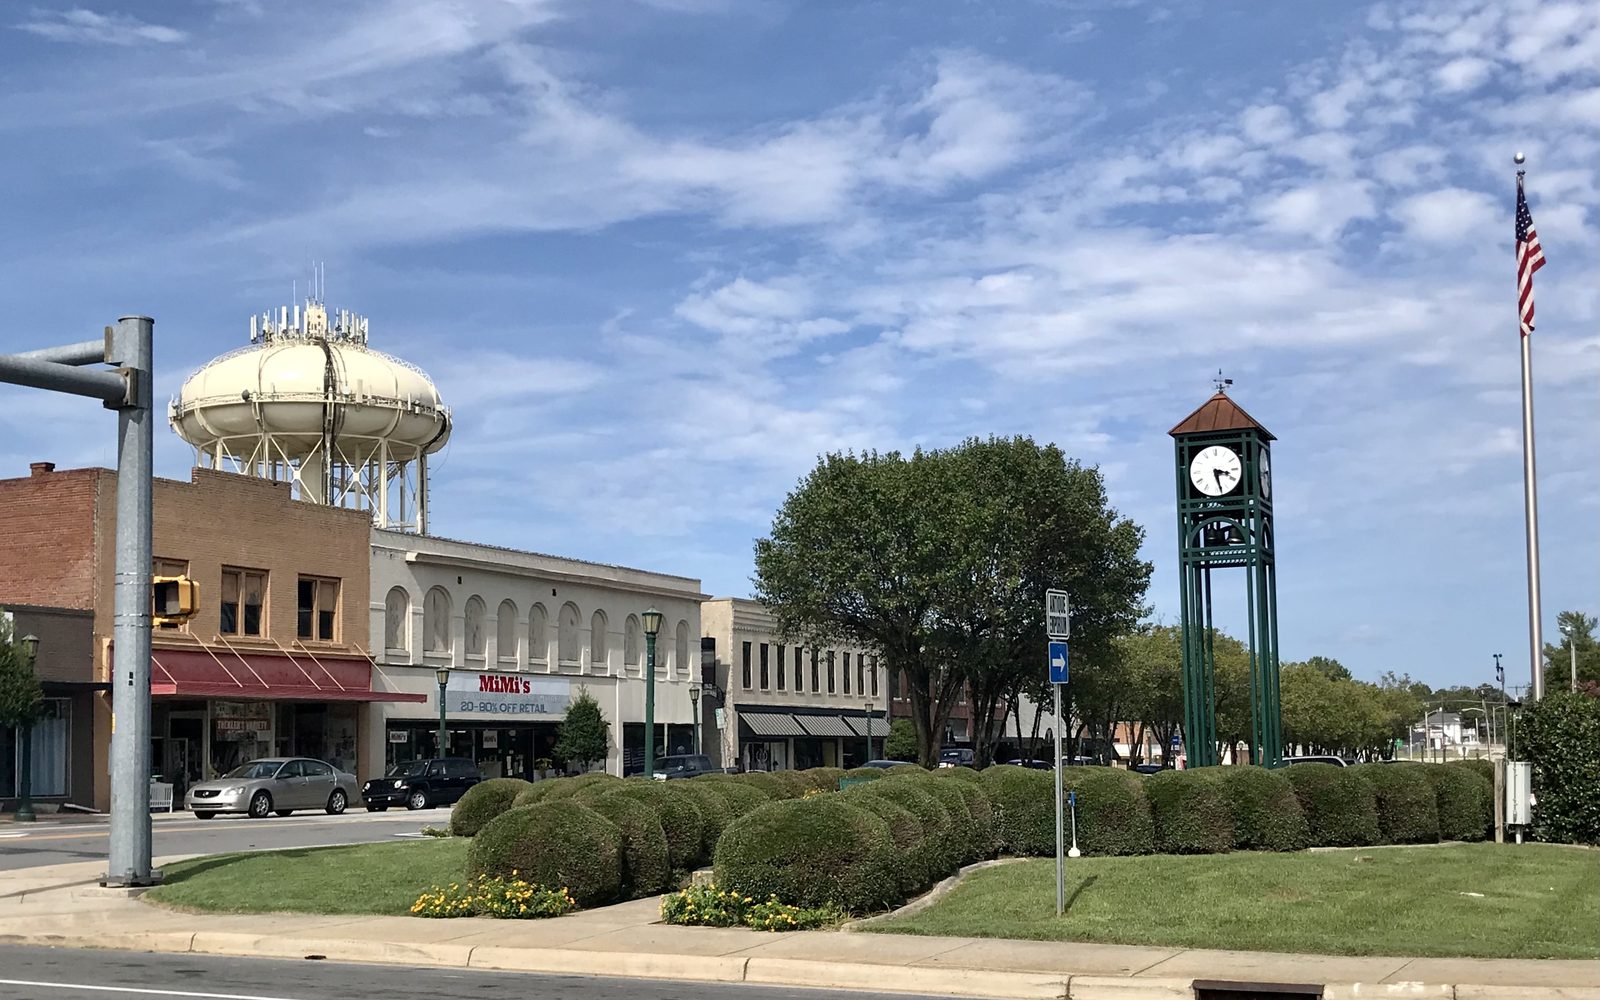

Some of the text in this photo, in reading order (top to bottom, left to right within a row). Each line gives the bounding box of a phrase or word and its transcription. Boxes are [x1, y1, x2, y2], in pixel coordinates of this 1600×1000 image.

[479, 675, 531, 693] MiMi's
[460, 701, 548, 713] 20-80% OFF RETAIL
